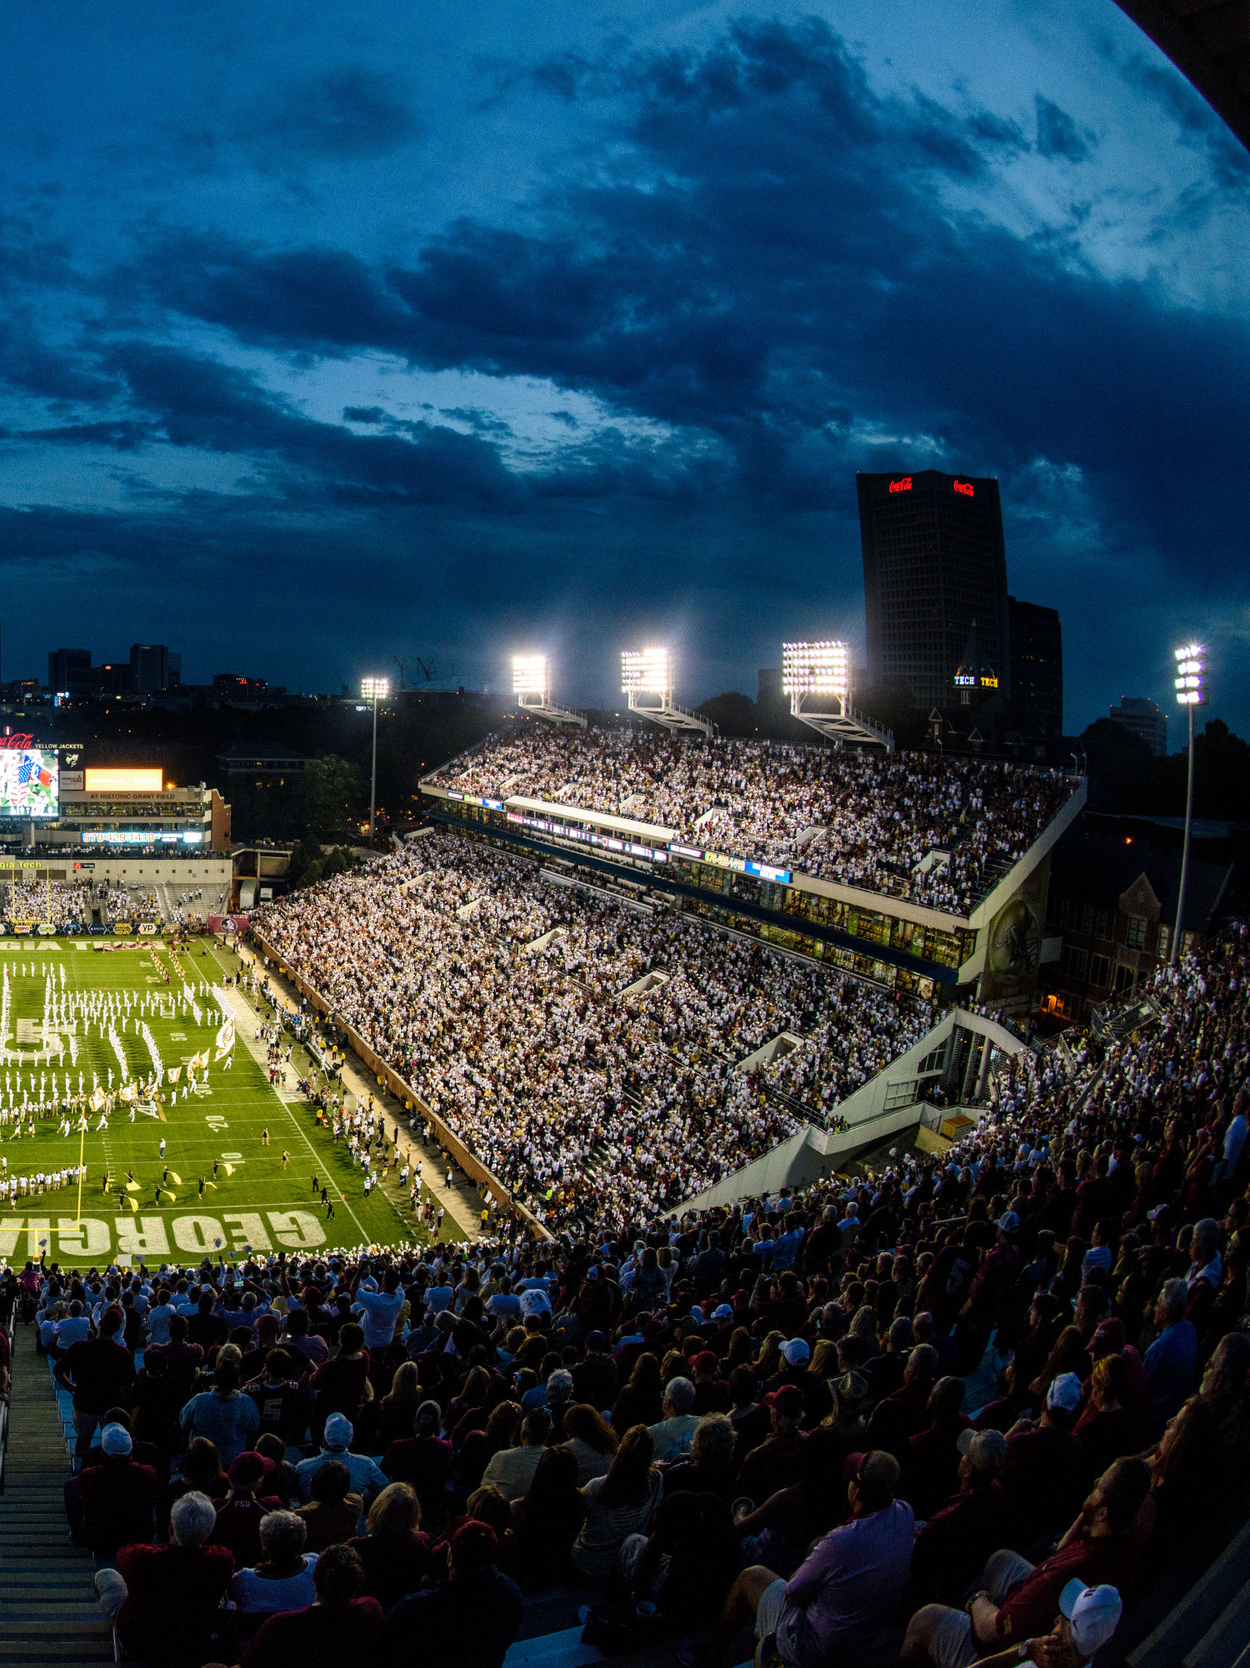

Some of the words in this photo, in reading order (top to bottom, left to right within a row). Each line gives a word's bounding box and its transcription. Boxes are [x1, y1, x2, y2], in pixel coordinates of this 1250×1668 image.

[889, 476, 912, 494] Coca-Cola
[953, 479, 975, 497] Coca-Cola
[954, 675, 975, 686] TECH
[980, 676, 999, 688] TECH
[18, 860, 42, 868] Tech
[69, 940, 167, 950] TECH
[945, 1255, 972, 1295] 5
[261, 1398, 284, 1421] 5
